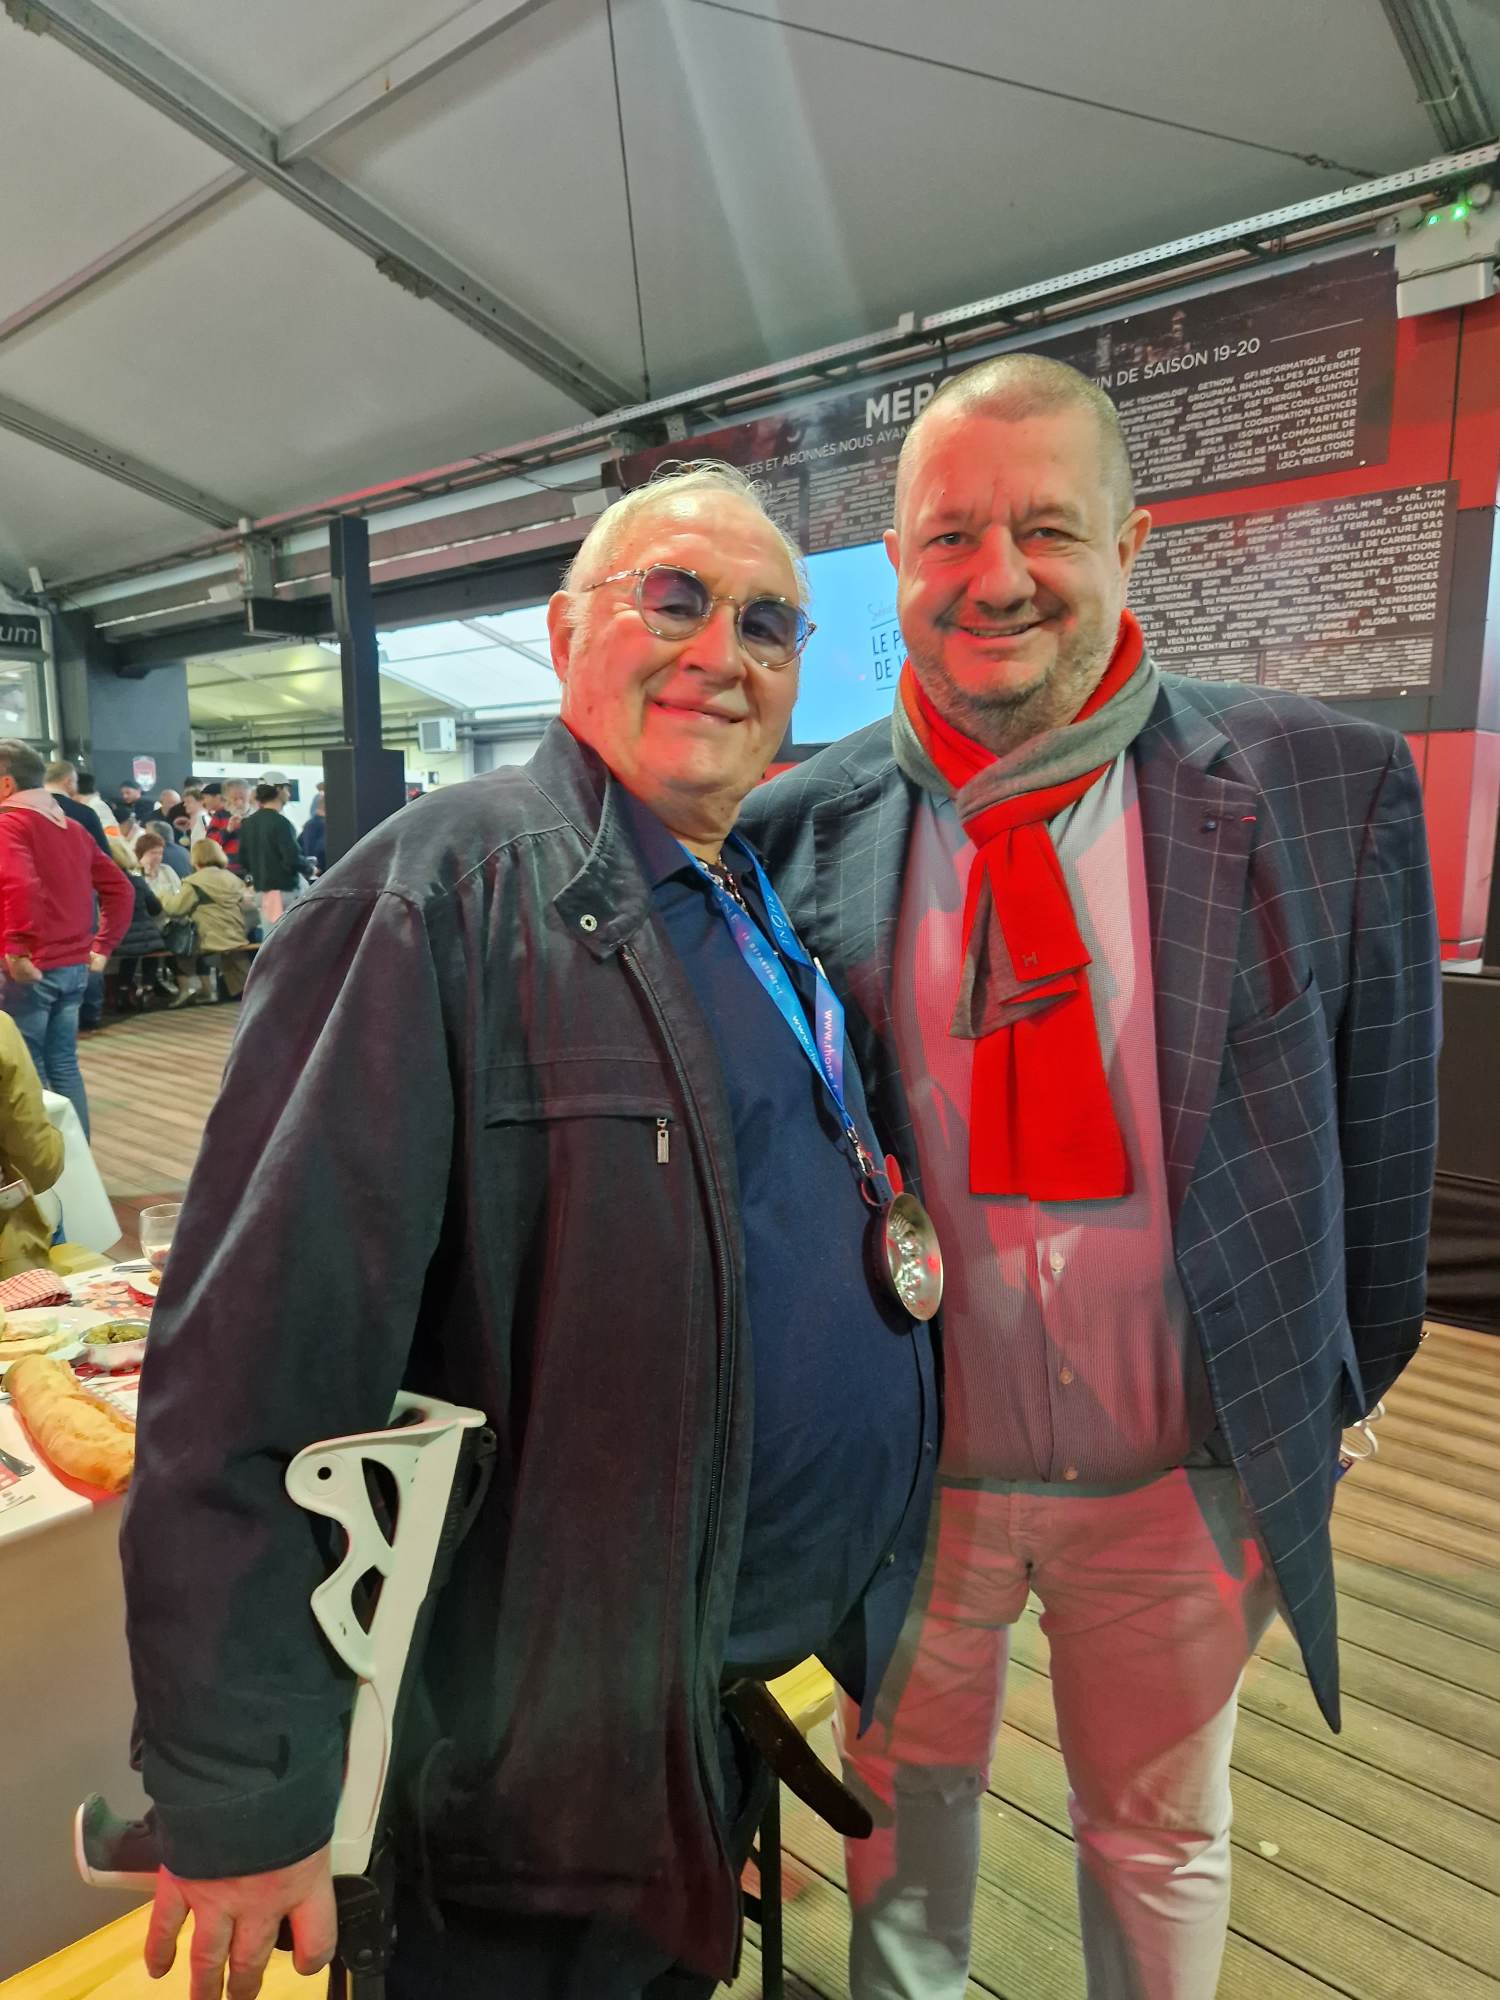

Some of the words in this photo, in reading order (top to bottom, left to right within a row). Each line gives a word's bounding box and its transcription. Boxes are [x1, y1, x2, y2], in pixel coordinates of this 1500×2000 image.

[1116, 367, 1139, 386] DE
[1143, 350, 1208, 379] SAISON
[1213, 337, 1260, 363] 19-20
[1260, 354, 1326, 376] INFORMATIQUE
[1336, 346, 1360, 359] GFTP
[1306, 357, 1359, 375] AUVERGNE
[1284, 376, 1320, 390] GROUPE
[1322, 367, 1359, 382] GACHET
[1263, 389, 1302, 405] ENERGIA
[1314, 377, 1358, 394] GUINTOLI
[1290, 390, 1347, 408] CONSULTING
[1244, 407, 1310, 428] COORDINATION
[1312, 398, 1356, 414] SERVICES
[1310, 408, 1356, 424] PARTNER
[1282, 422, 1338, 440] COMPAGNIE
[1296, 428, 1354, 447] LAGARRIGUE
[766, 457, 780, 472] ET
[839, 433, 873, 452] NOUS
[1302, 448, 1352, 466] RECEPTION
[1333, 502, 1356, 513] SARL
[1360, 498, 1382, 508] MMB
[1396, 492, 1422, 503] SARL
[1425, 488, 1445, 498] T2M
[1382, 505, 1401, 515] SCP
[1404, 498, 1444, 512] GAUVIN
[1310, 524, 1340, 536] SERGE
[1344, 517, 1386, 531] FERRARI
[1401, 509, 1443, 522] SEROBA
[1360, 522, 1418, 539] SIGNATURE
[1422, 519, 1442, 529] SAS
[1380, 529, 1441, 546] CARRELAGE)
[1376, 539, 1440, 557] PRESTATIONS
[1407, 550, 1440, 562] SOLOC
[1392, 559, 1439, 574] SYNDICAT
[1392, 569, 1439, 585] SERVICES
[1394, 579, 1437, 594] TOSHIBA
[1379, 590, 1436, 606] VENISSIEUX
[1391, 600, 1435, 615] TELECOM
[1408, 610, 1435, 623] VINCI
[872, 633, 888, 655] LE
[875, 658, 892, 680] DE
